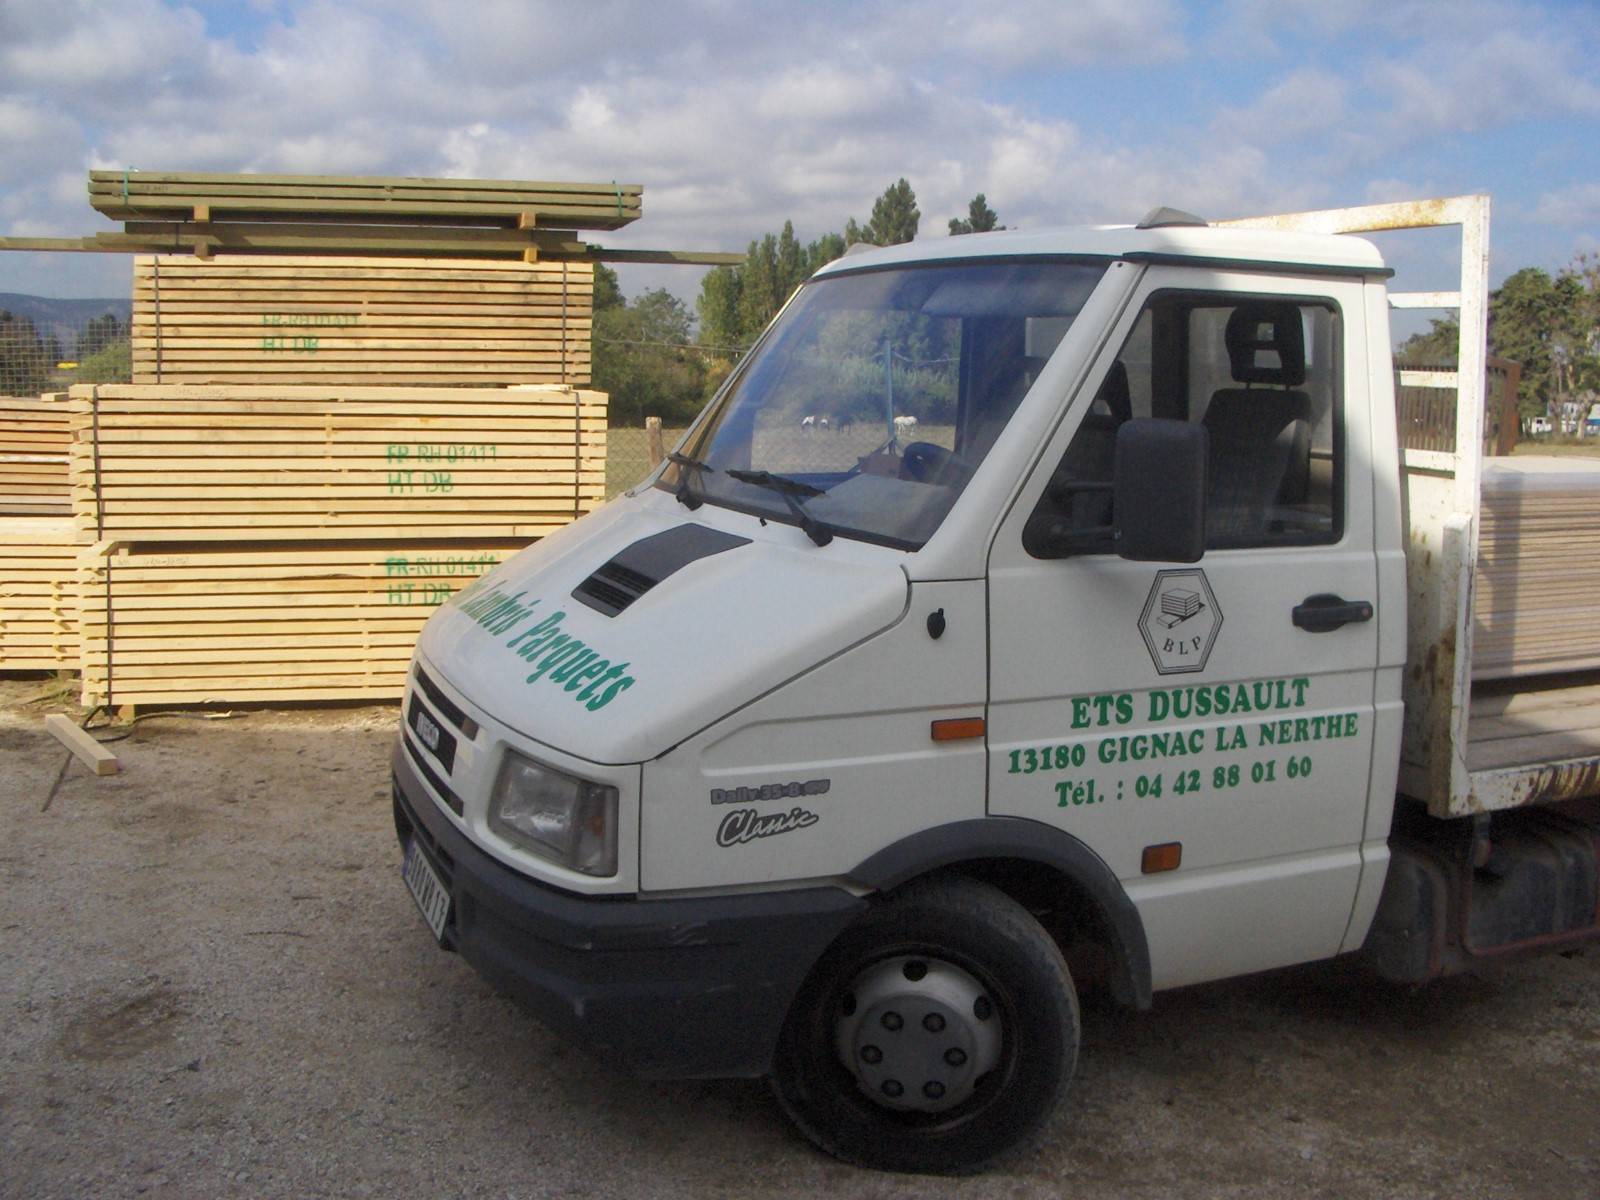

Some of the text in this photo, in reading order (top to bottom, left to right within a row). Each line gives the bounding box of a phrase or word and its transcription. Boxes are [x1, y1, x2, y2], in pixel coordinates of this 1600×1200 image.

[447, 445, 497, 463] 01411
[387, 471, 454, 493] HT DB
[387, 582, 416, 604] HT
[506, 611, 637, 711] Parquets
[1070, 677, 1309, 729] ETS DUSSAULT
[1007, 712, 1359, 773] 13180 GIGNAC LA NERTHE
[1055, 779, 1104, 807] Tél.
[1135, 774, 1162, 799] 04
[1173, 769, 1200, 795] 42
[1212, 764, 1240, 789] 88
[1251, 758, 1276, 783] 01
[1286, 755, 1313, 779] 60
[716, 807, 819, 847] Classic
